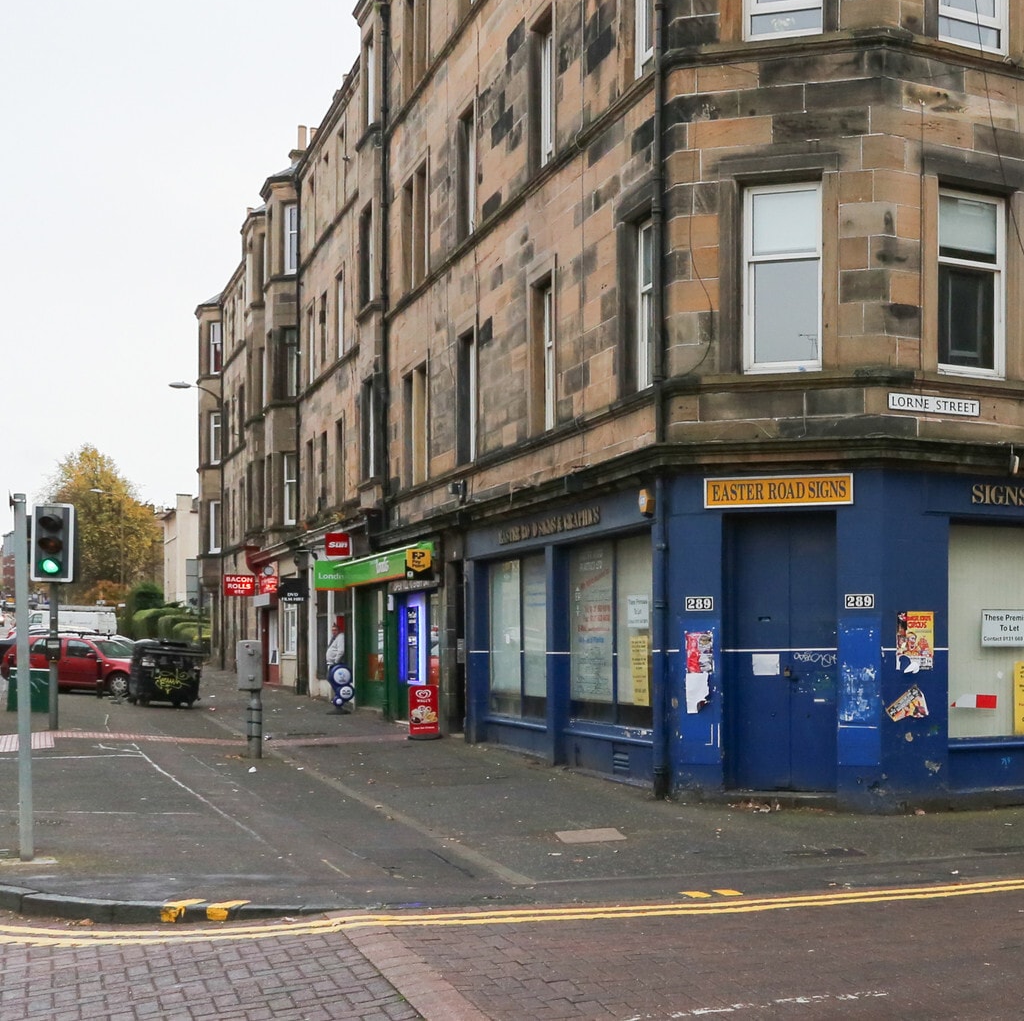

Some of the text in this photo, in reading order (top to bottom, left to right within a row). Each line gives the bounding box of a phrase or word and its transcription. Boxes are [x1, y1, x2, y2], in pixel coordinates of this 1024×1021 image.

[892, 396, 976, 413] LORNE STREET
[712, 480, 846, 501] EASTER ROAD SIGNS
[687, 598, 712, 609] 289
[847, 595, 872, 607] 289
